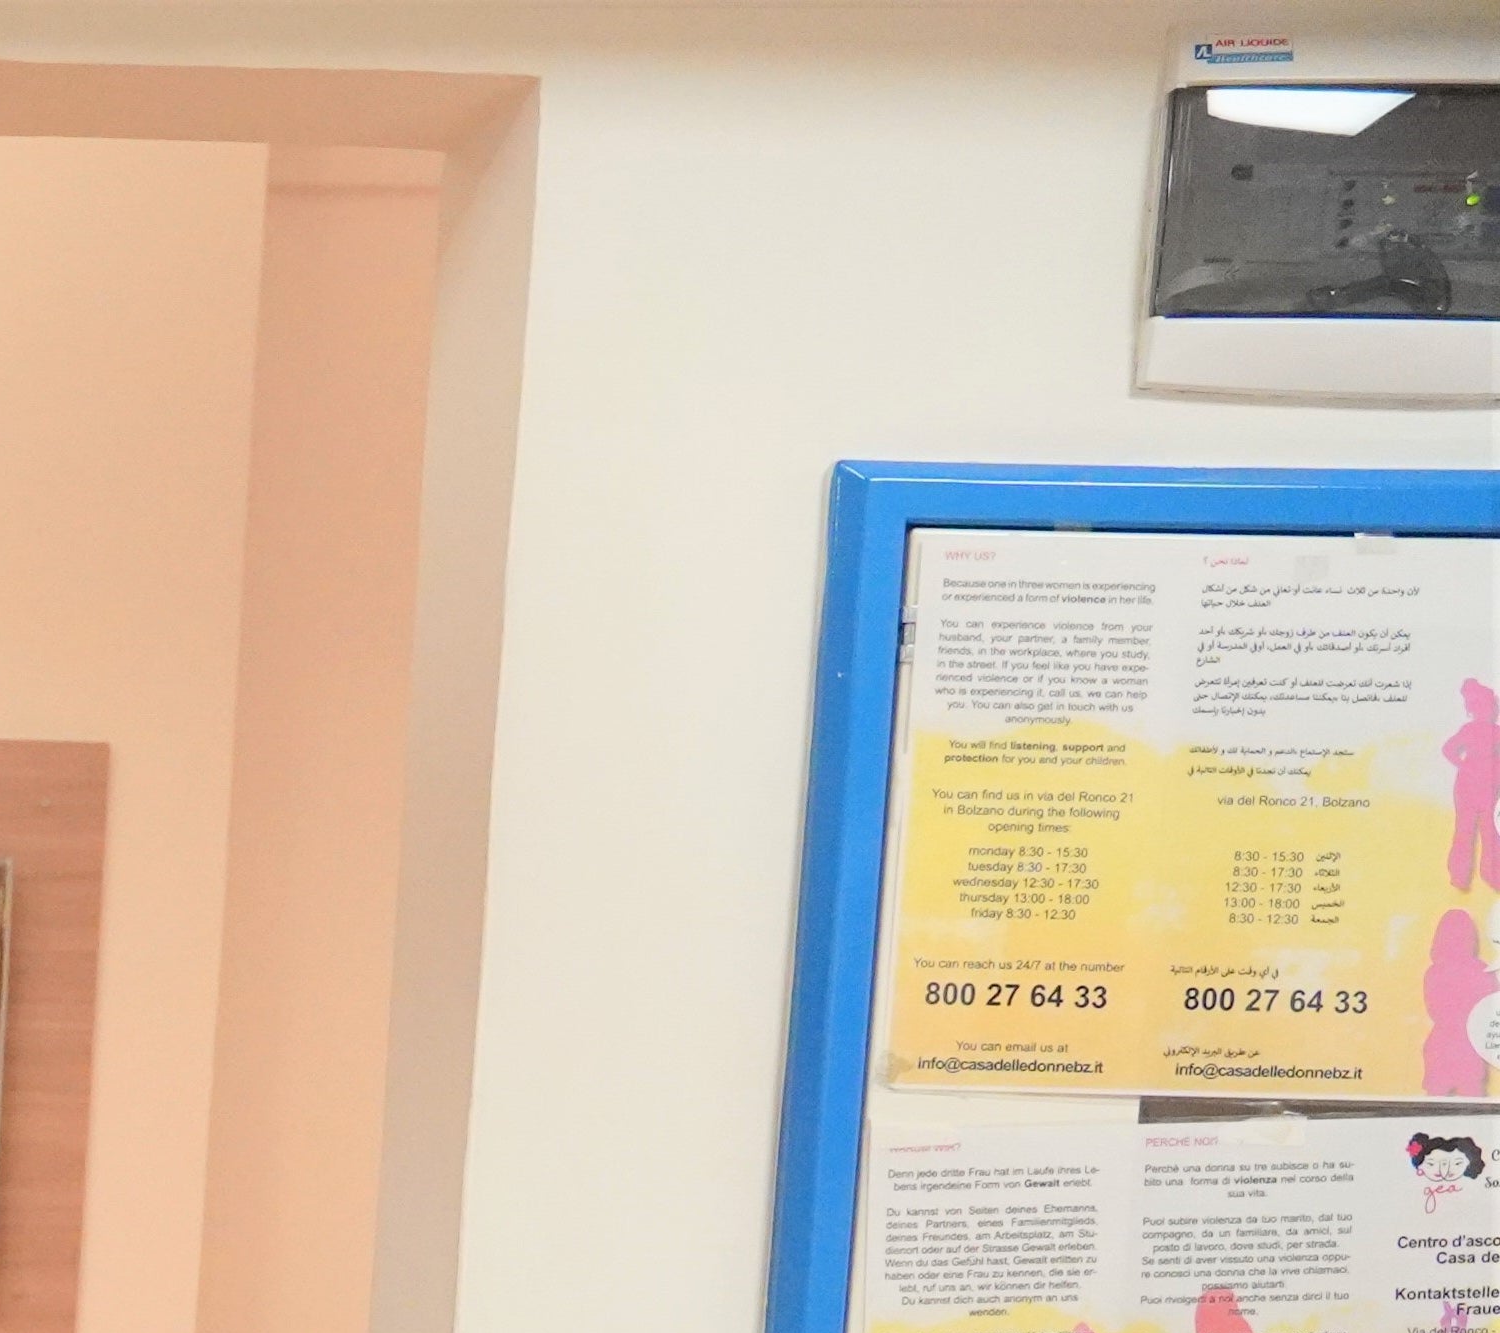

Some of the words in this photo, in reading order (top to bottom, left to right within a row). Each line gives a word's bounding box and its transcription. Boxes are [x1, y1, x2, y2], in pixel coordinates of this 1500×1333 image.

[1215, 39, 1235, 47] AIR
[1241, 38, 1289, 47] LIQUIDE
[945, 551, 971, 561] WHY
[932, 788, 953, 800] You
[957, 791, 978, 800] can
[982, 789, 1003, 800] find
[1006, 792, 1020, 801] us
[1024, 790, 1034, 801] in
[1037, 791, 1054, 801] via
[1057, 791, 1075, 802] del
[1079, 792, 1116, 803] Ronco
[1120, 793, 1134, 803] 21
[1217, 797, 1234, 806] via
[1237, 796, 1255, 807] del
[1259, 796, 1296, 807] Ronco
[1322, 797, 1370, 808] Bolzano
[944, 804, 953, 814] in
[958, 805, 1004, 816] Bolzano
[1007, 806, 1043, 819] during
[1047, 807, 1066, 817] the
[1069, 808, 1120, 821] following
[988, 822, 1034, 834] opening
[968, 846, 1015, 859] monday
[1018, 847, 1044, 857] 8:30
[1056, 848, 1088, 858] 15:30
[925, 982, 976, 1006] 800
[986, 983, 1020, 1007] 27
[1030, 984, 1064, 1008] 64
[1075, 985, 1107, 1009] 33
[1184, 987, 1235, 1011] 800
[1245, 988, 1279, 1012] 27
[1290, 990, 1324, 1013] 64
[1334, 990, 1368, 1014] 33
[917, 1056, 1103, 1074] info@casadelledonnebz.it
[1175, 1063, 1363, 1080] info@casadelledonnebz.it
[1397, 1235, 1448, 1249] Centro
[1436, 1251, 1476, 1265] Casa
[1395, 1285, 1500, 1301] Kontaktstelle
